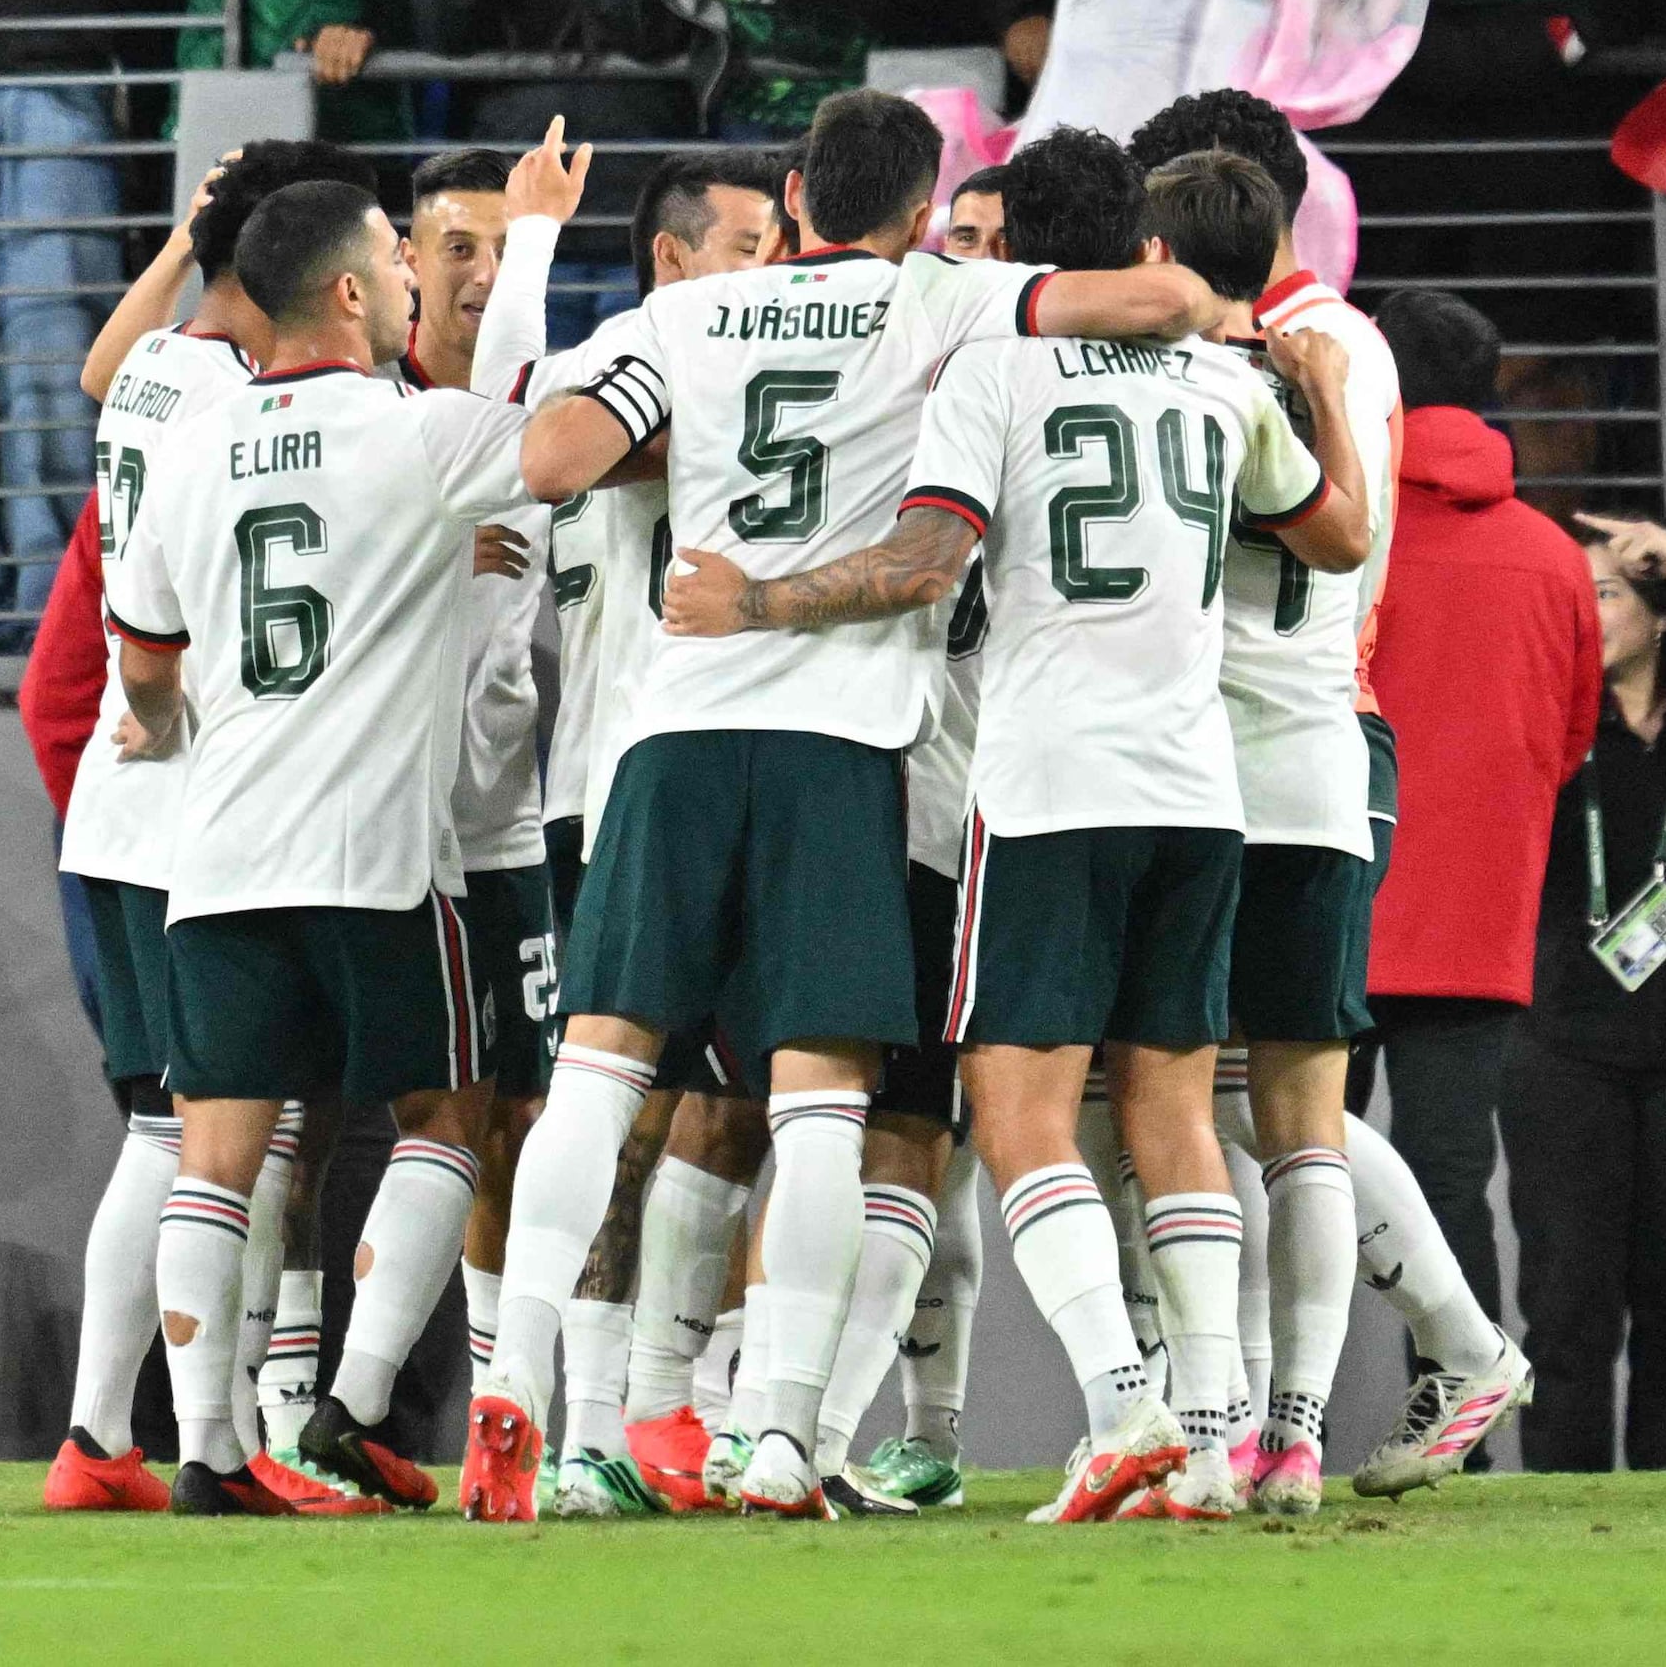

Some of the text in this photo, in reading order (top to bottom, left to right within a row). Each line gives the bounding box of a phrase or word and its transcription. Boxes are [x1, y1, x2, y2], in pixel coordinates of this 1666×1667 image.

[707, 298, 890, 342] J.VÁSQUEZ
[230, 430, 322, 481] E.LIRA
[729, 370, 844, 545] 5
[1043, 404, 1229, 616] 24
[234, 502, 334, 701] 6
